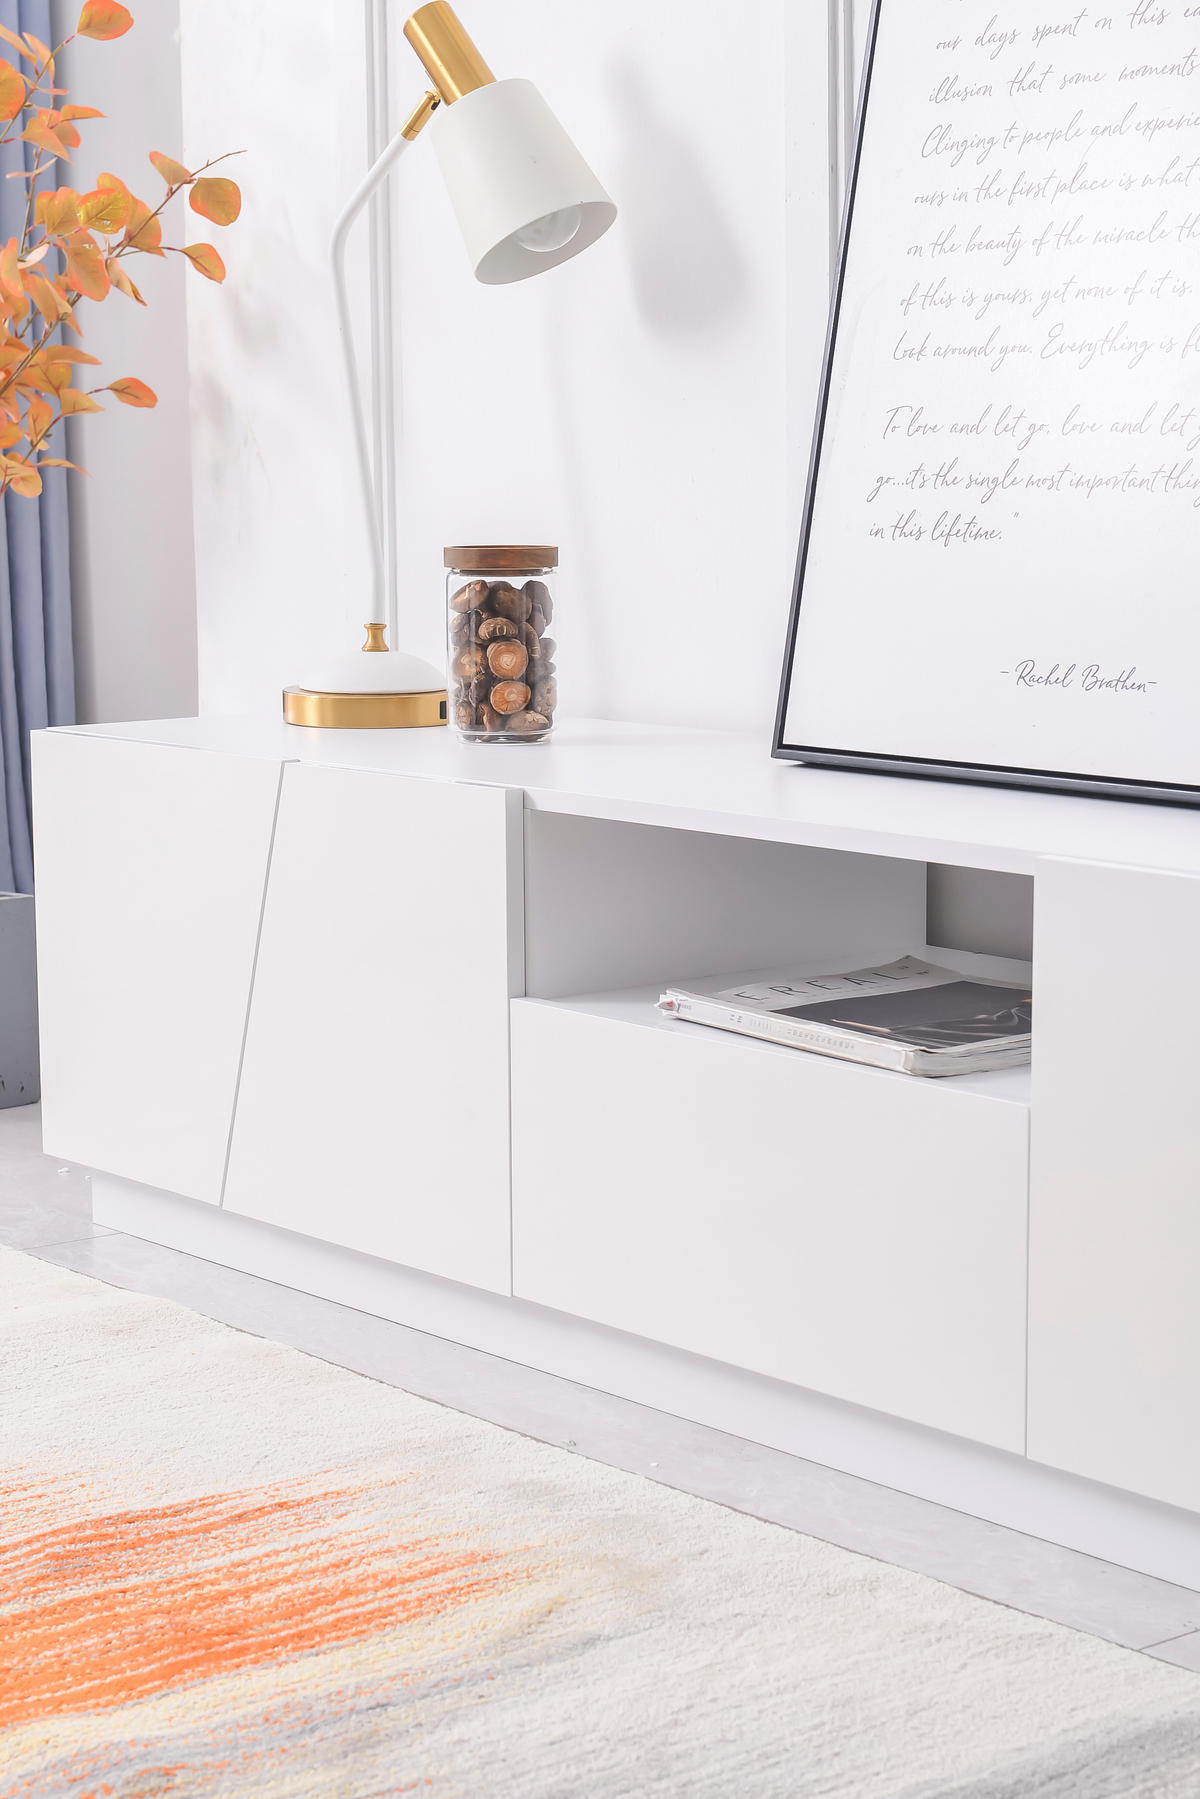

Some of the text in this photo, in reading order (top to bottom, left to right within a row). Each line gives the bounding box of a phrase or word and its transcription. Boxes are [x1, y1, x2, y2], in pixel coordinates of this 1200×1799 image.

[936, 35, 962, 51] our
[974, 14, 1022, 60] days
[1031, 8, 1088, 48] spent
[1094, 17, 1112, 30] on
[1127, 0, 1171, 29] this
[929, 48, 1200, 104] illusion that some moments
[921, 123, 1000, 168] Clinging
[1003, 121, 1020, 149] to
[1018, 109, 1089, 154] people
[1090, 102, 1138, 137] and
[914, 156, 1200, 206] ours in the first place is what
[907, 244, 924, 257] on
[929, 224, 962, 258] the
[965, 224, 1025, 267] beauty
[1031, 221, 1056, 256] of
[1055, 214, 1090, 250] the
[1092, 210, 1171, 246] miracle
[900, 282, 924, 317] of
[922, 277, 956, 310] this
[961, 287, 977, 307] is
[1032, 274, 1078, 318] yet
[1074, 286, 1120, 301] none
[1123, 269, 1146, 305] of
[1150, 269, 1174, 300] it
[893, 330, 932, 361] Look
[932, 325, 1001, 357] around
[1040, 321, 1154, 370] Everything
[1159, 336, 1179, 354] is
[882, 405, 914, 439] To
[907, 405, 944, 437] love
[949, 403, 993, 435] and
[993, 404, 1027, 437] let
[1061, 403, 1103, 437] love
[1109, 401, 1158, 435] and
[1159, 402, 1198, 437] let
[930, 458, 962, 490] the
[965, 458, 1022, 504] single
[1025, 463, 1072, 492] most
[1069, 463, 1168, 499] important
[869, 523, 884, 538] in
[889, 509, 928, 542] this
[931, 510, 1003, 548] lifetime.
